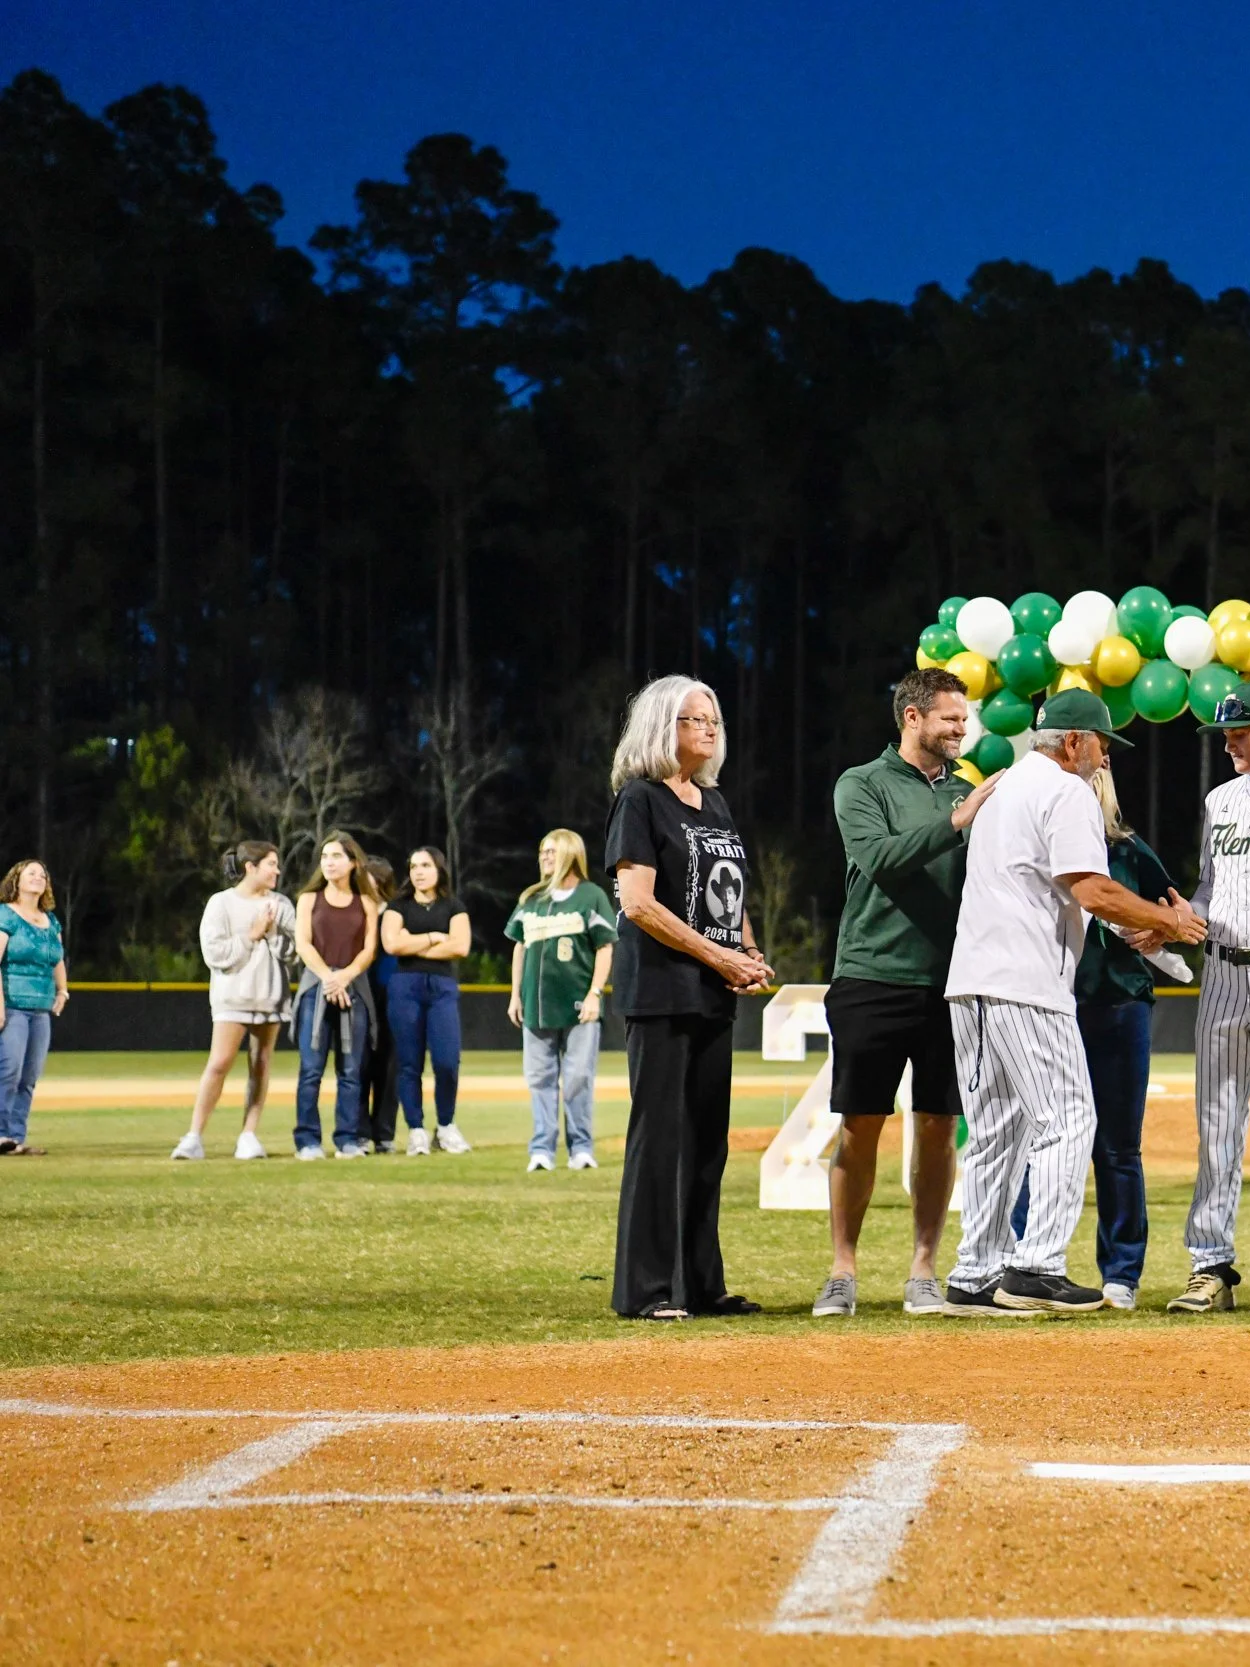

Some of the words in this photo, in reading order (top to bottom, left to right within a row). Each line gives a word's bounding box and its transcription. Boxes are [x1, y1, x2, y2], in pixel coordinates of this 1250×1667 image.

[701, 840, 746, 859] STRAIT
[703, 926, 728, 941] 2024
[730, 930, 742, 943] TOU
